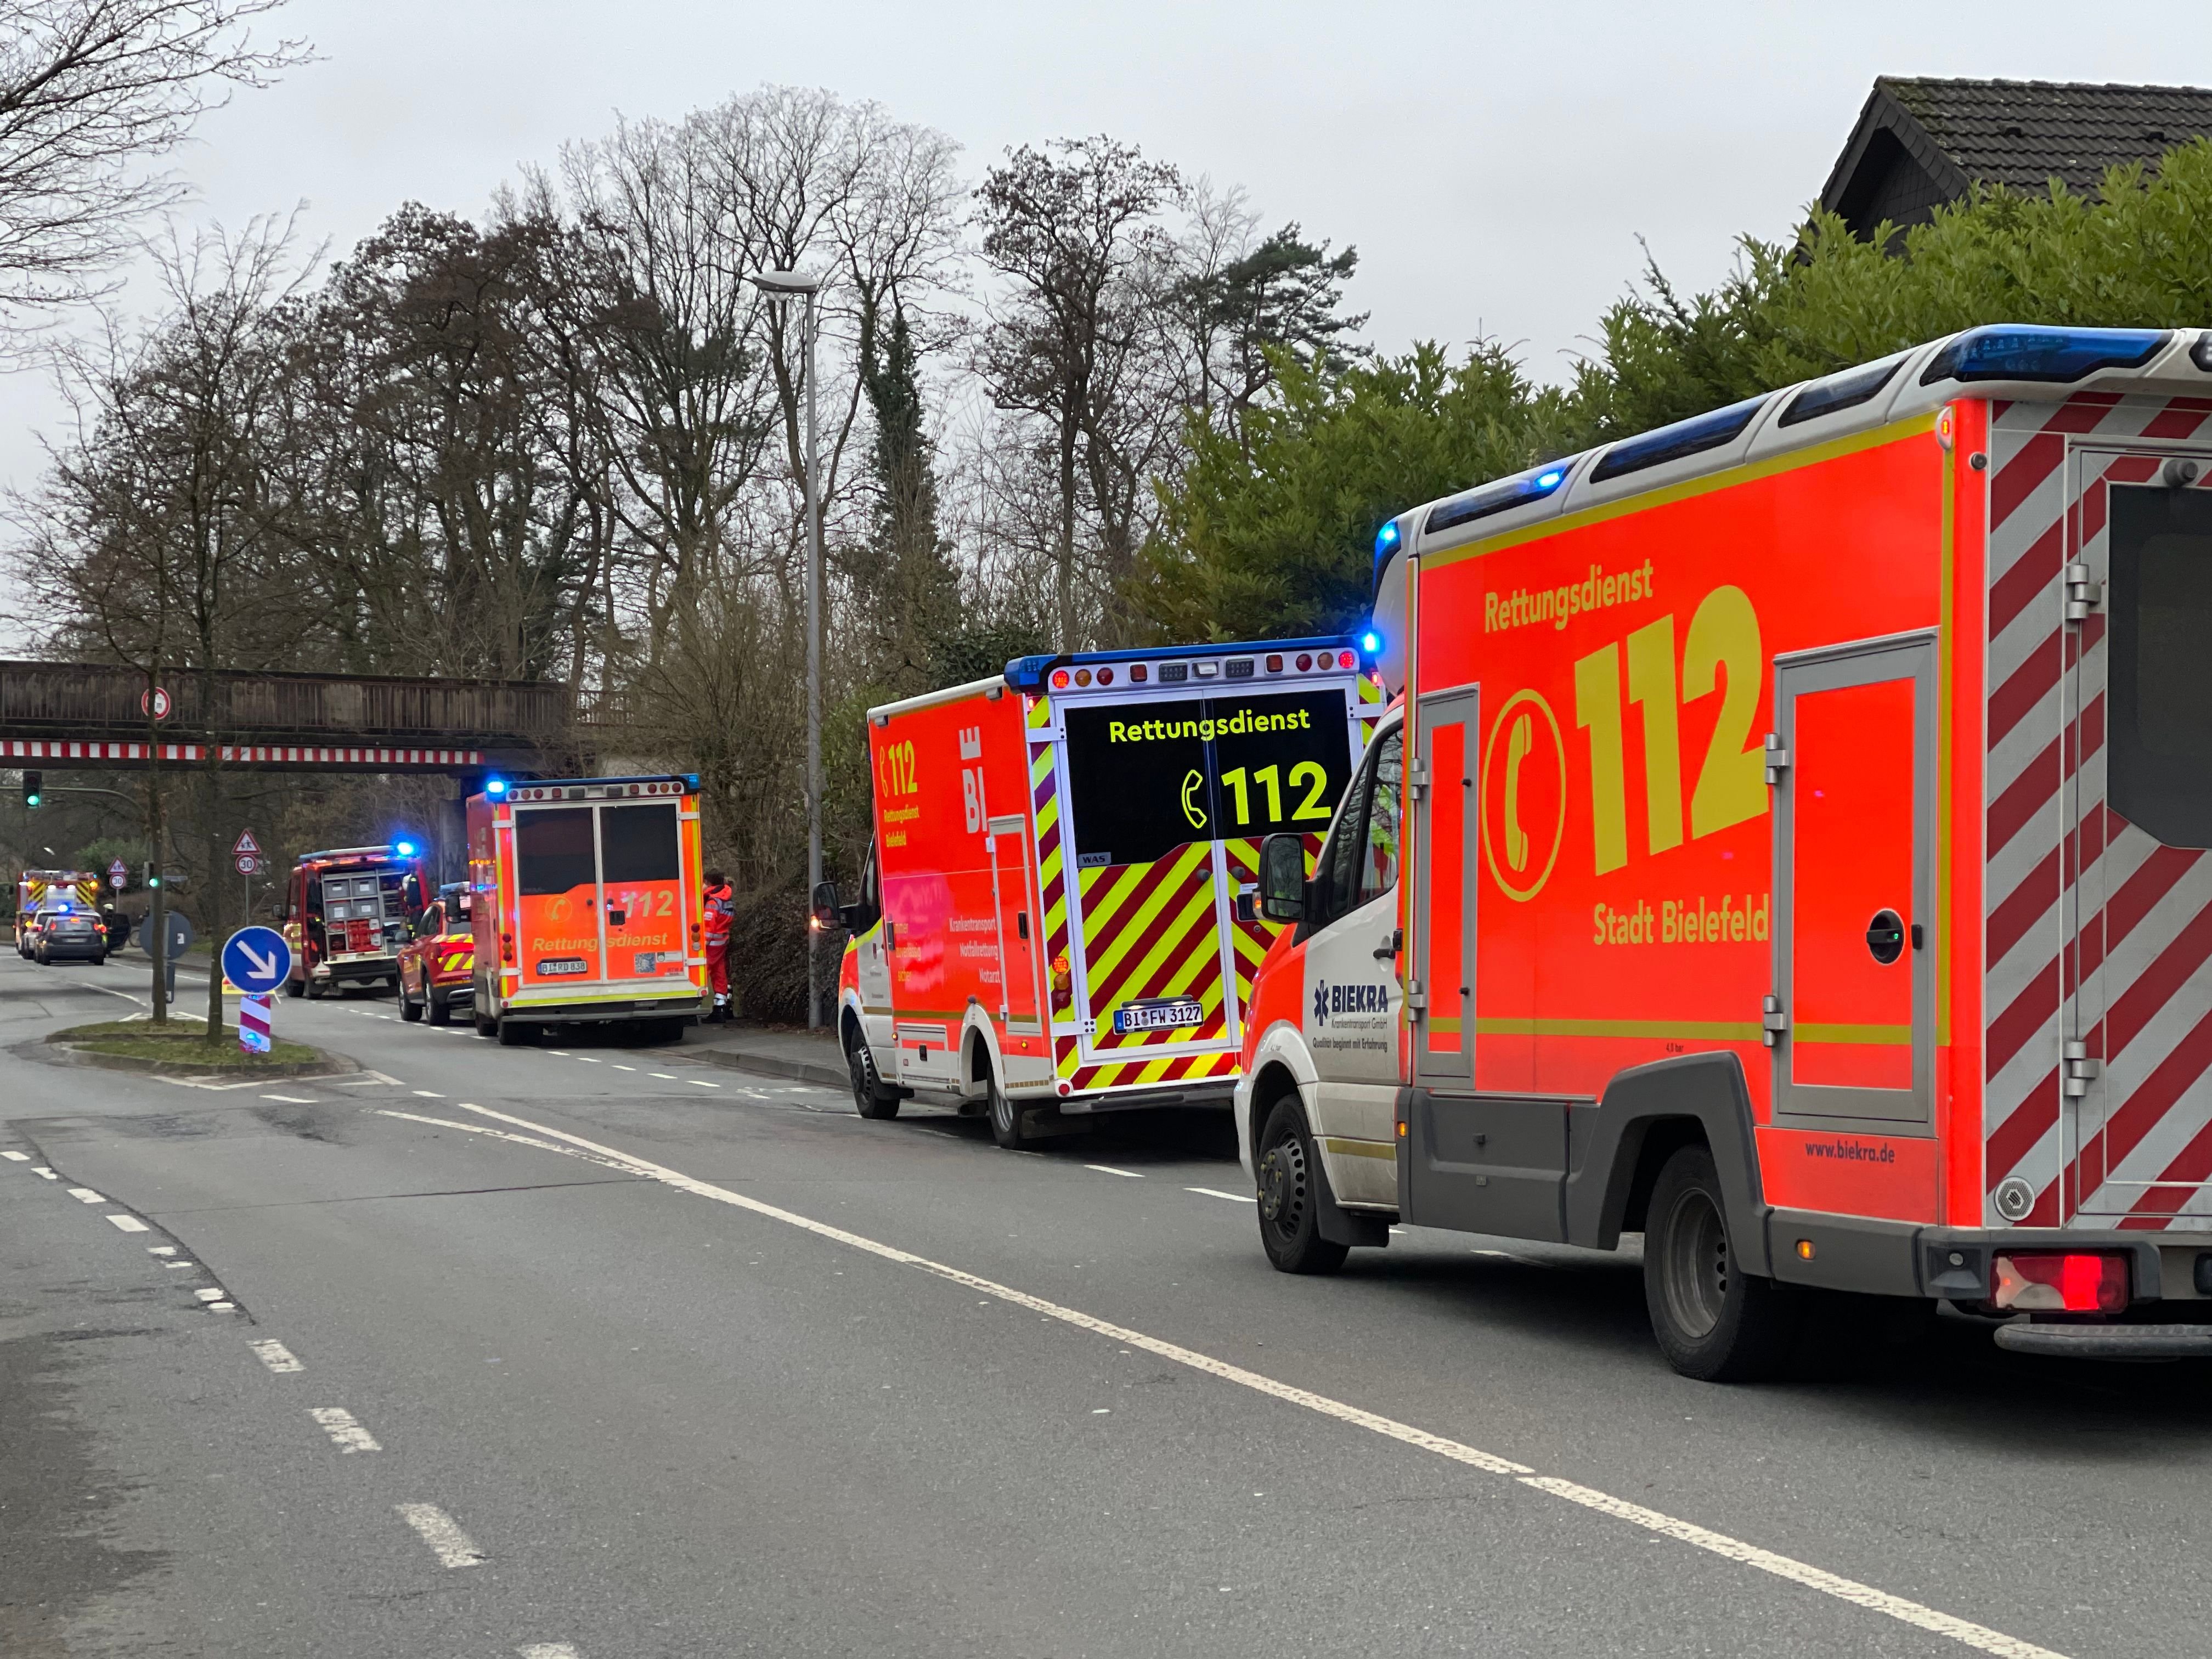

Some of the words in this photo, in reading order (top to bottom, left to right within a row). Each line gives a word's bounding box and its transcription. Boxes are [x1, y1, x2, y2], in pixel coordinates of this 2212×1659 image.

[1485, 558, 1654, 633] Rettungsdienst
[1109, 709, 1311, 743] Rettungsdienst
[1575, 585, 1769, 876] 112
[888, 740, 917, 795] 112
[962, 766, 988, 834] BI
[1221, 761, 1331, 825] 112
[884, 804, 919, 824] Rettungsdienst
[886, 830, 907, 848] Bielefeld
[241, 860, 252, 868] 30
[622, 890, 674, 918] 112
[949, 915, 997, 934] Krankentransport
[1594, 900, 1654, 945] Stadt
[1663, 894, 1769, 943] Bielefeld
[532, 933, 668, 952] Rettungsdienst
[960, 940, 998, 961] Notfallrettung
[542, 964, 552, 972] BI
[557, 963, 569, 971] RD
[571, 962, 585, 970] 838
[979, 968, 1001, 983] Notarzt
[1332, 985, 1389, 1013] BIEKRA
[1124, 1013, 1140, 1027] BI
[1150, 1009, 1166, 1024] FW
[1170, 1007, 1200, 1023] 3127
[1331, 1017, 1370, 1031] Krankentransport
[1372, 1017, 1387, 1029] GmbH
[1313, 1037, 1331, 1048] Qualität
[1333, 1037, 1351, 1051] beginnt
[1352, 1037, 1361, 1049] mit
[1362, 1037, 1387, 1053] Erfahrung
[1805, 1139, 1895, 1163] www.biekra.de
